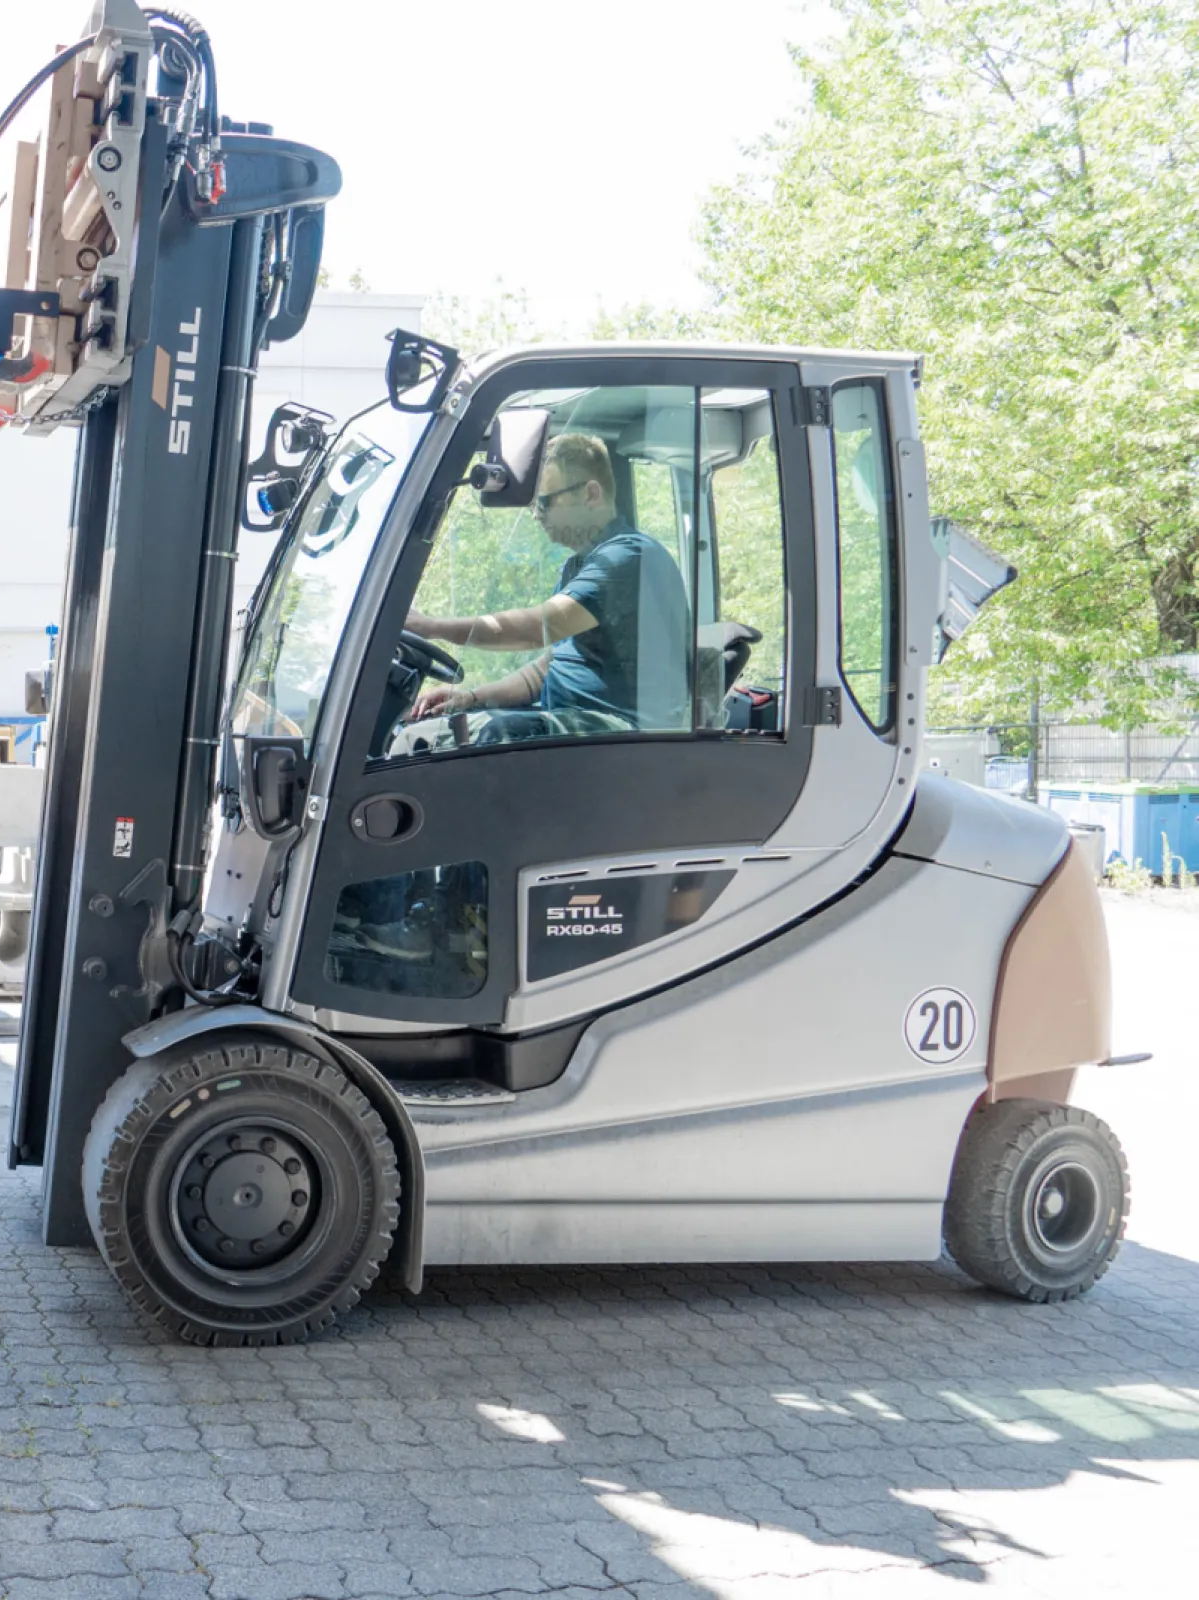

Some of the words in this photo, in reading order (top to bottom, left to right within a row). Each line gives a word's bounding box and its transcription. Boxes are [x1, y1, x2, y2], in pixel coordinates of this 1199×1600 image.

[168, 307, 202, 454] STILL
[547, 906, 623, 920] STILL
[547, 923, 623, 937] RX60-45
[919, 1000, 963, 1051] 20
